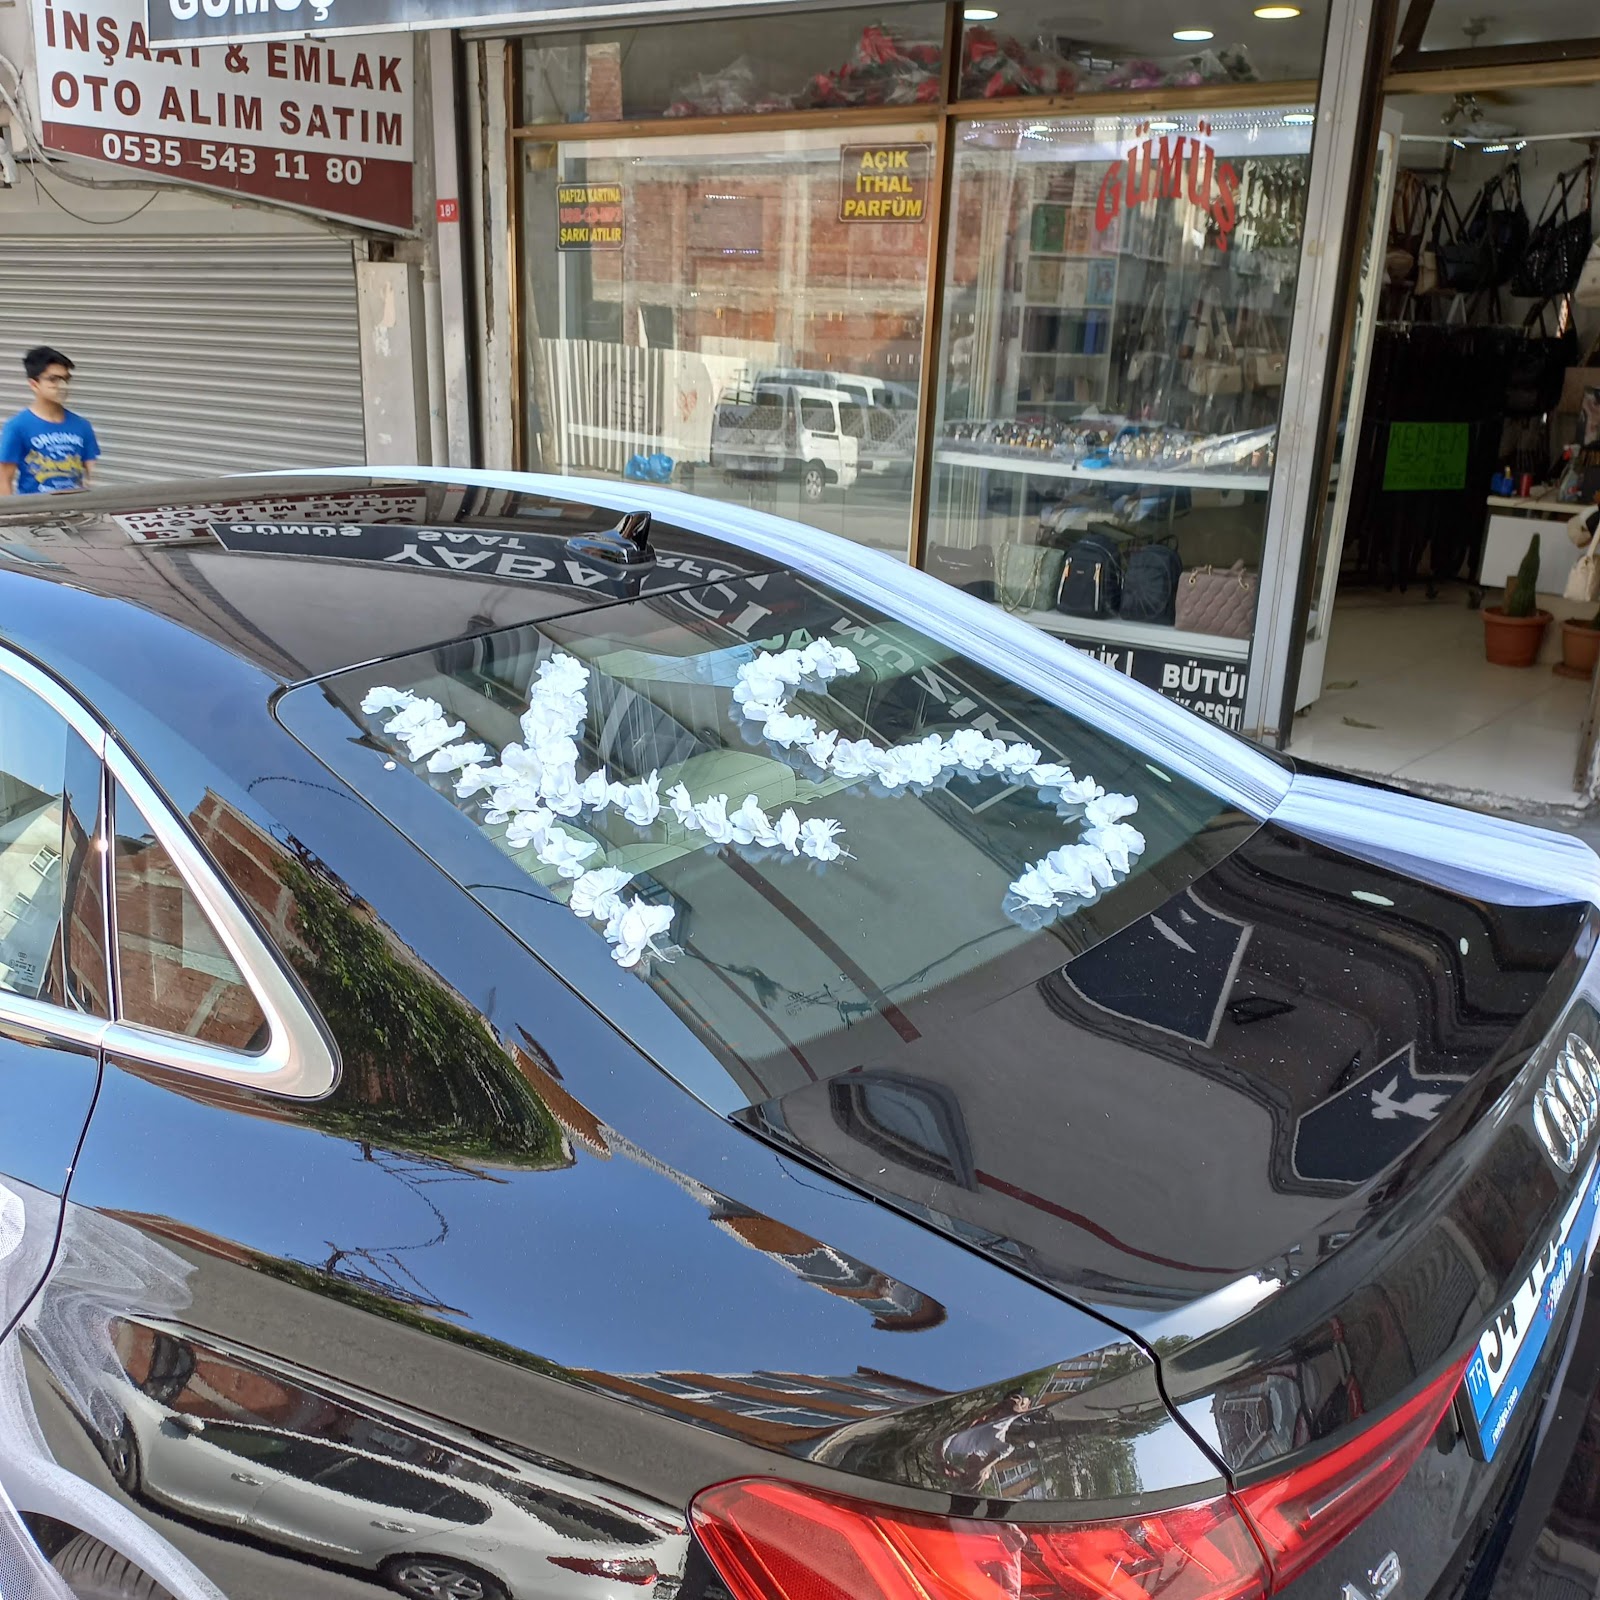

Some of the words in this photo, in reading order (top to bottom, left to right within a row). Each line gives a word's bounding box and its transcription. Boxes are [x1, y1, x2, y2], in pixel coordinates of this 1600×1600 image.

[224, 43, 250, 75] &
[267, 41, 403, 94] EMLAK
[51, 71, 142, 116] OTO
[158, 85, 263, 131] ALIM
[279, 100, 403, 147] SATIM
[102, 132, 183, 167] 0535
[199, 144, 257, 175] 543
[274, 152, 310, 181] 11
[325, 157, 363, 186] 80
[861, 150, 909, 173] AÇIK
[559, 188, 588, 204] HAFIZA
[855, 171, 914, 194] İTHAL
[1094, 120, 1240, 254] GÜMÜŞ
[844, 196, 922, 217] PARFÜM
[561, 228, 590, 246] ŞARKI
[590, 227, 622, 242] ATILIR
[1162, 659, 1247, 700] BÜTÜ
[1469, 1357, 1487, 1396] TR
